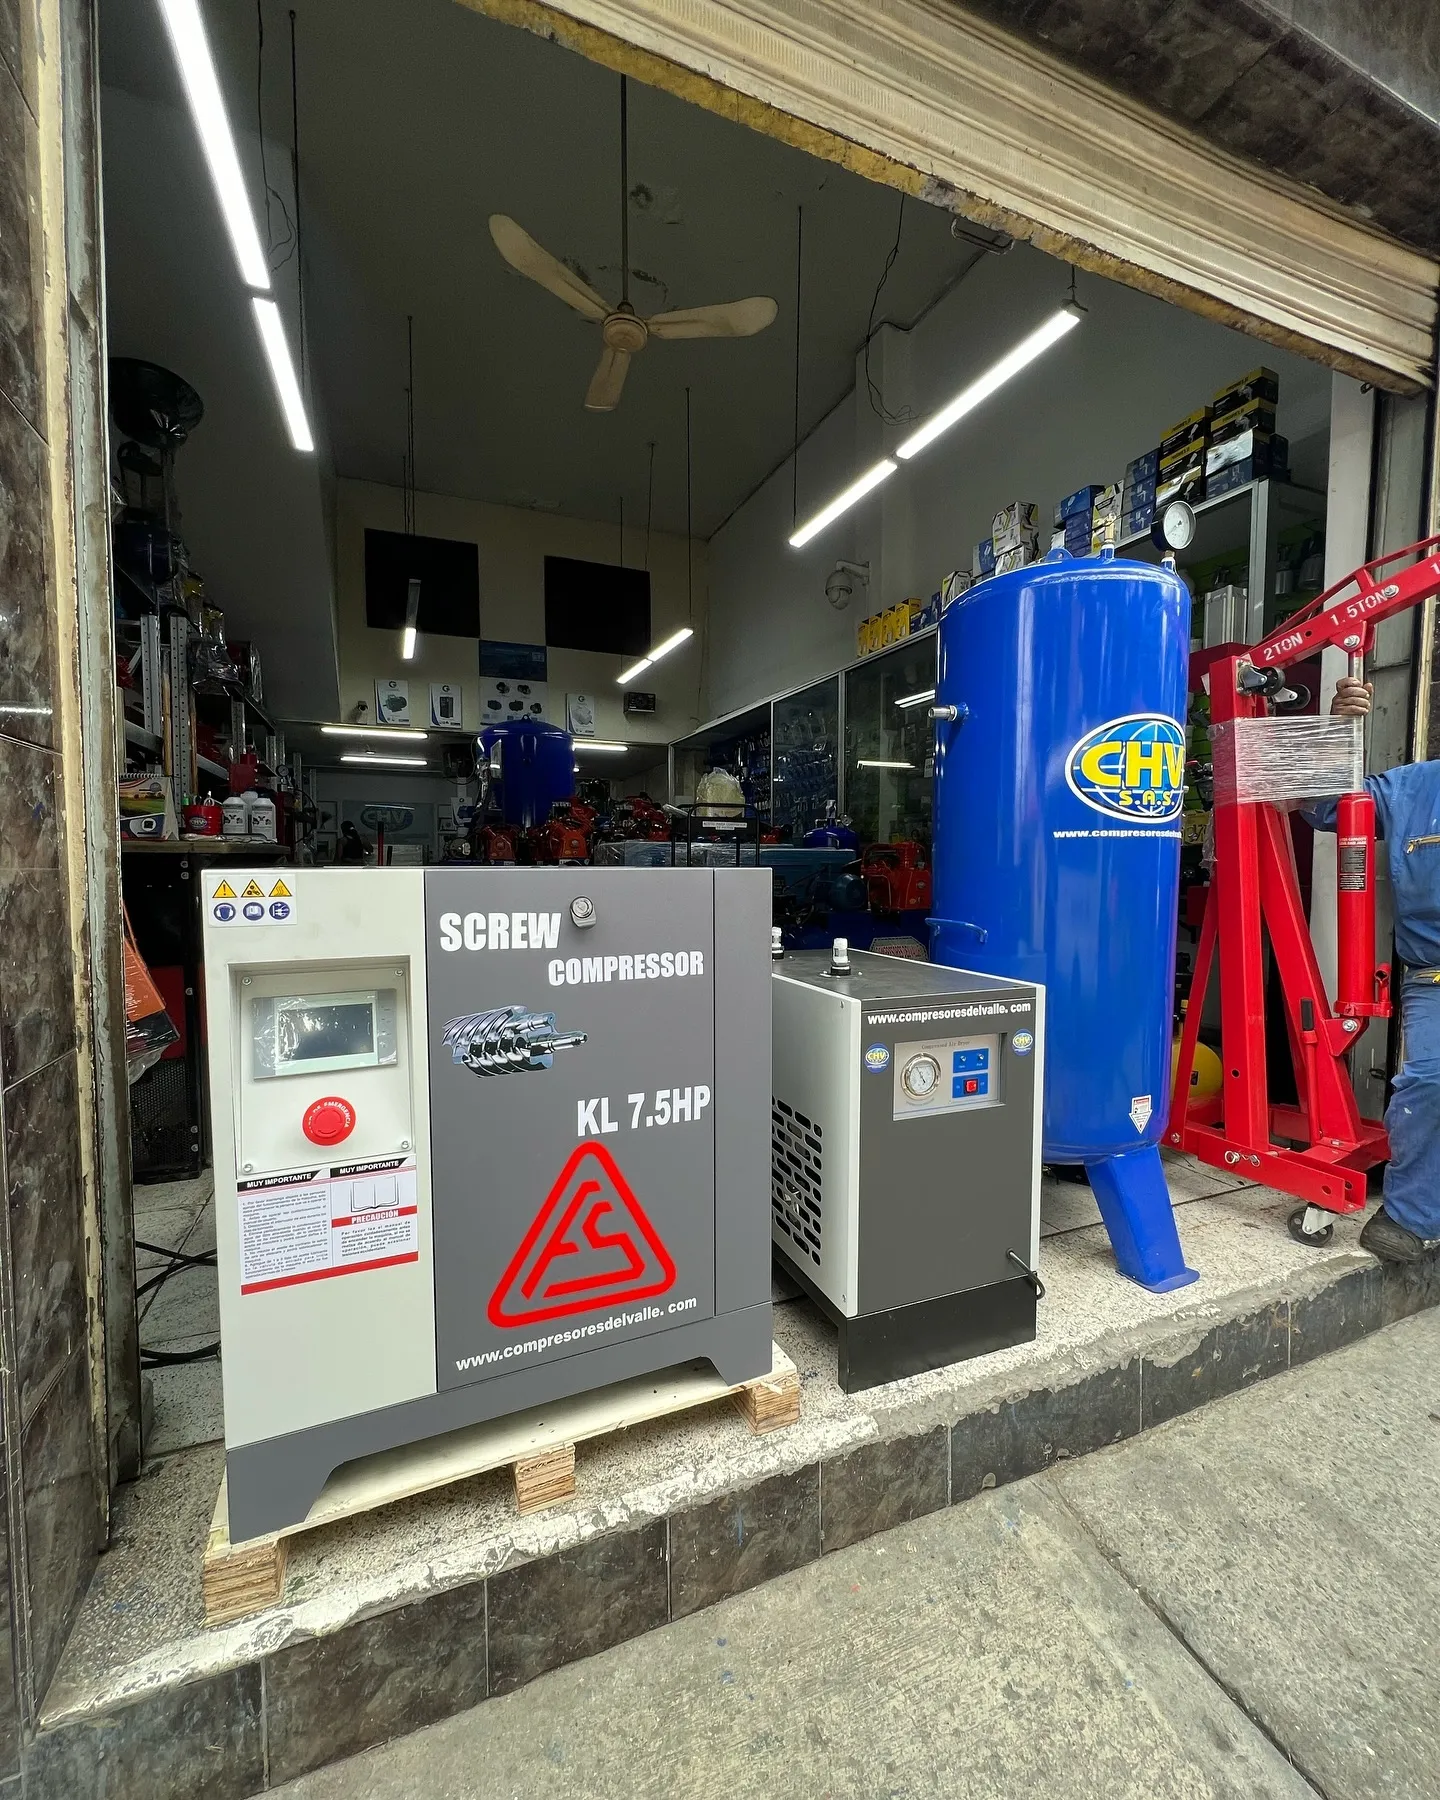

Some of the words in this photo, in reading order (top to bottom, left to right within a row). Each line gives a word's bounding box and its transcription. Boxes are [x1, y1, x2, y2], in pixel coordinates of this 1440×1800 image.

[1263, 632, 1303, 661] 2TON
[1080, 741, 1185, 788] CHV
[439, 912, 562, 951] SCREW
[548, 951, 704, 986] COMPRESSOR
[577, 1097, 618, 1137] KL
[628, 1085, 711, 1129] 7.5HP
[247, 1181, 264, 1189] MUY
[265, 1172, 312, 1185] IMPORTANTE
[340, 1166, 355, 1174] MUY
[356, 1160, 399, 1172] IMPORTANTE
[351, 1209, 399, 1224] PRECAUCIÓN
